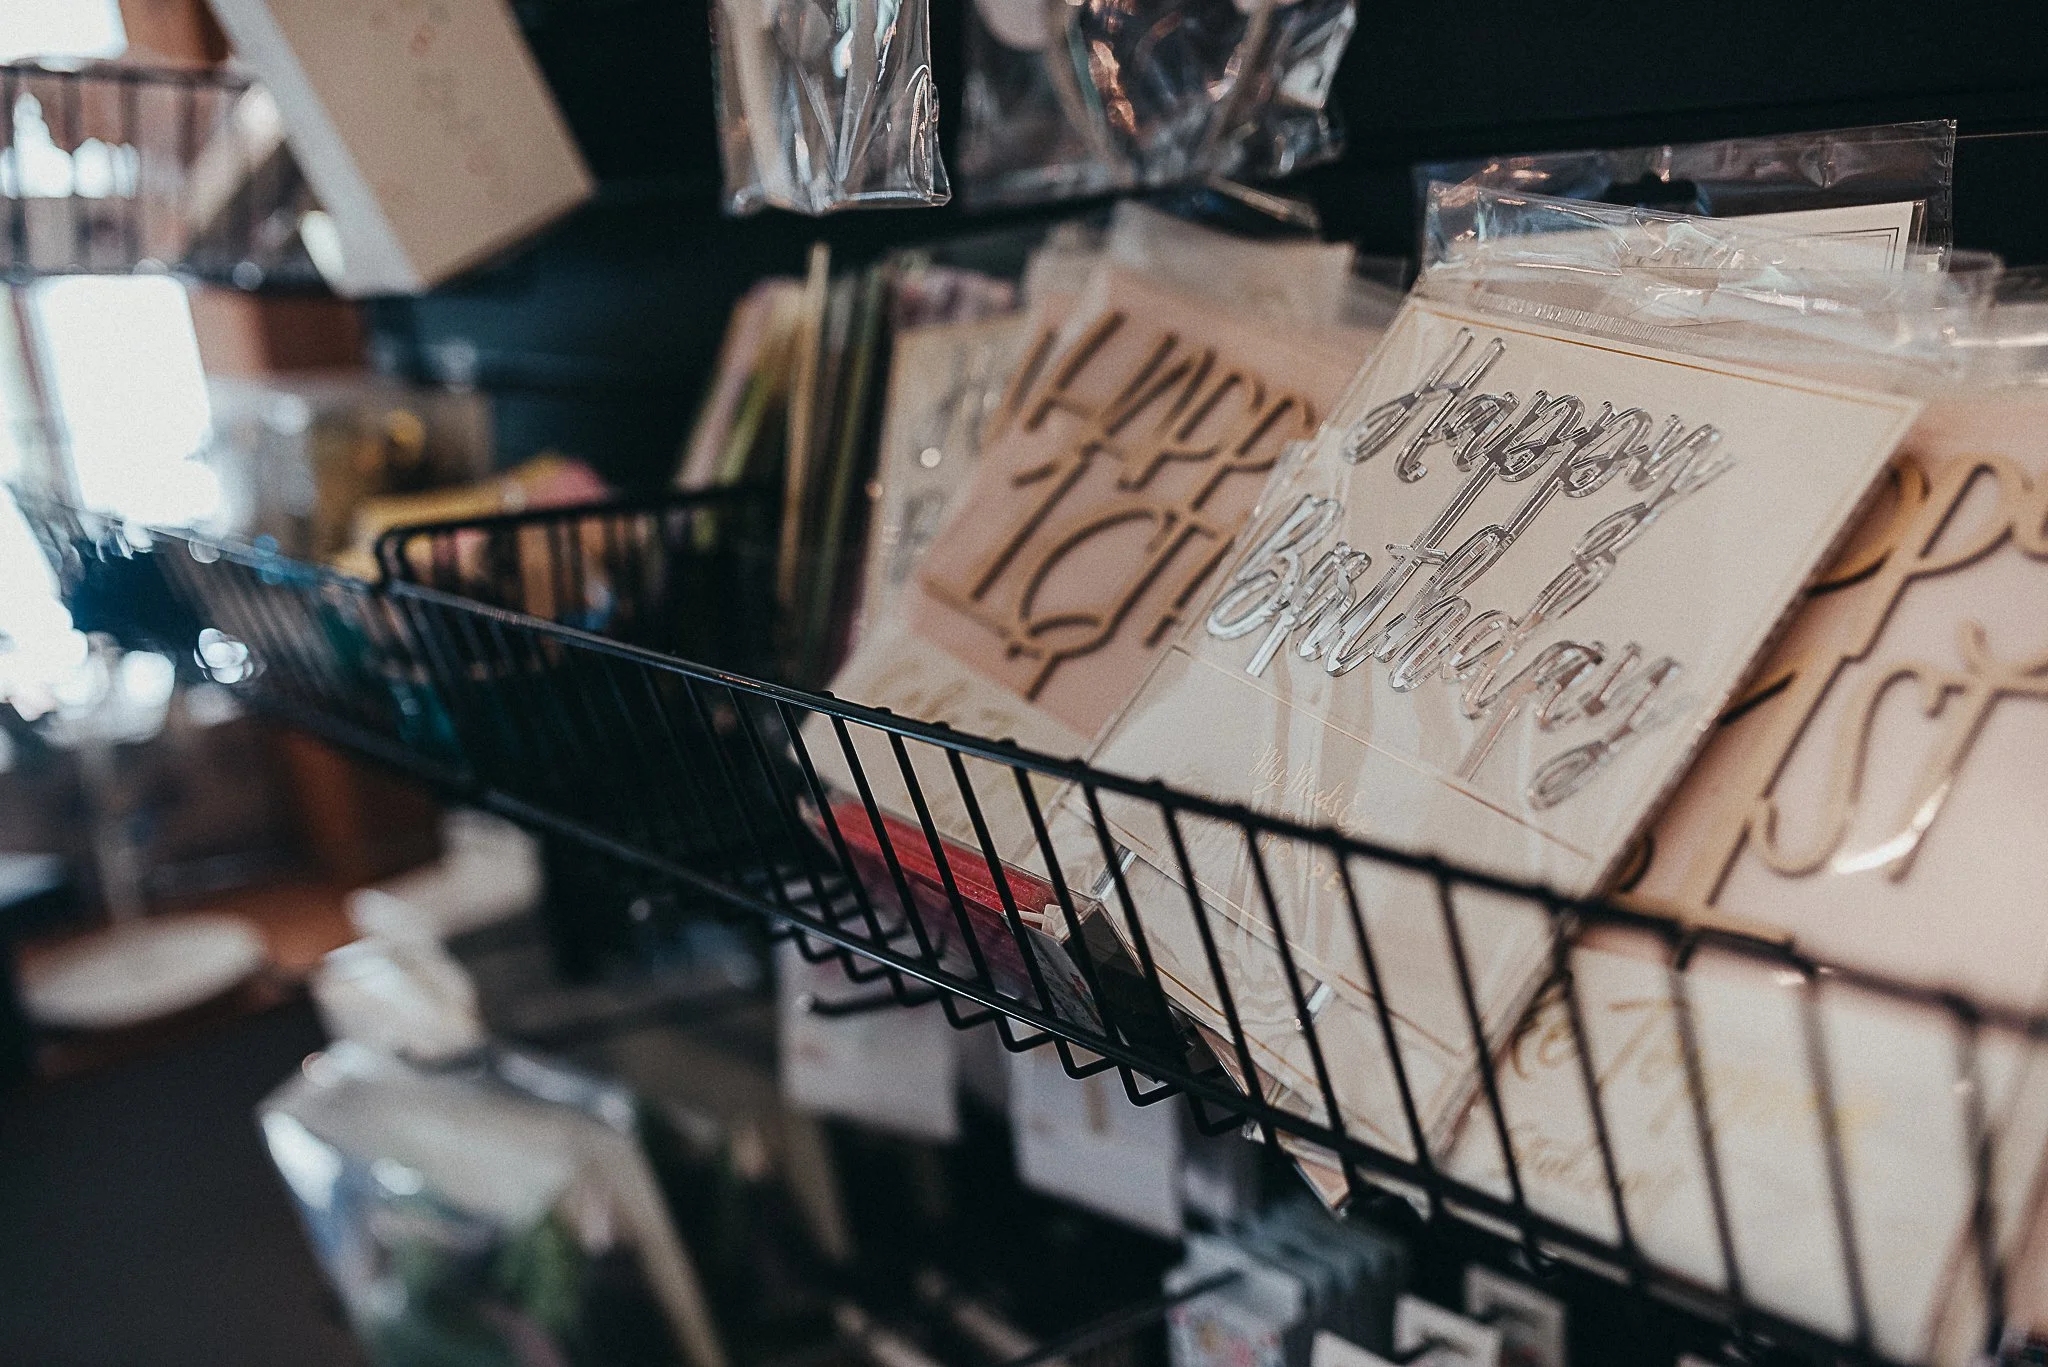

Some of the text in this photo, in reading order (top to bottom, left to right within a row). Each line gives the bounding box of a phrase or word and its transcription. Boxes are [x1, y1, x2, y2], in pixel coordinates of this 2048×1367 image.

[1343, 325, 1735, 560] Happy
[1205, 492, 1695, 811] Birthday
[1247, 743, 1287, 794] My
